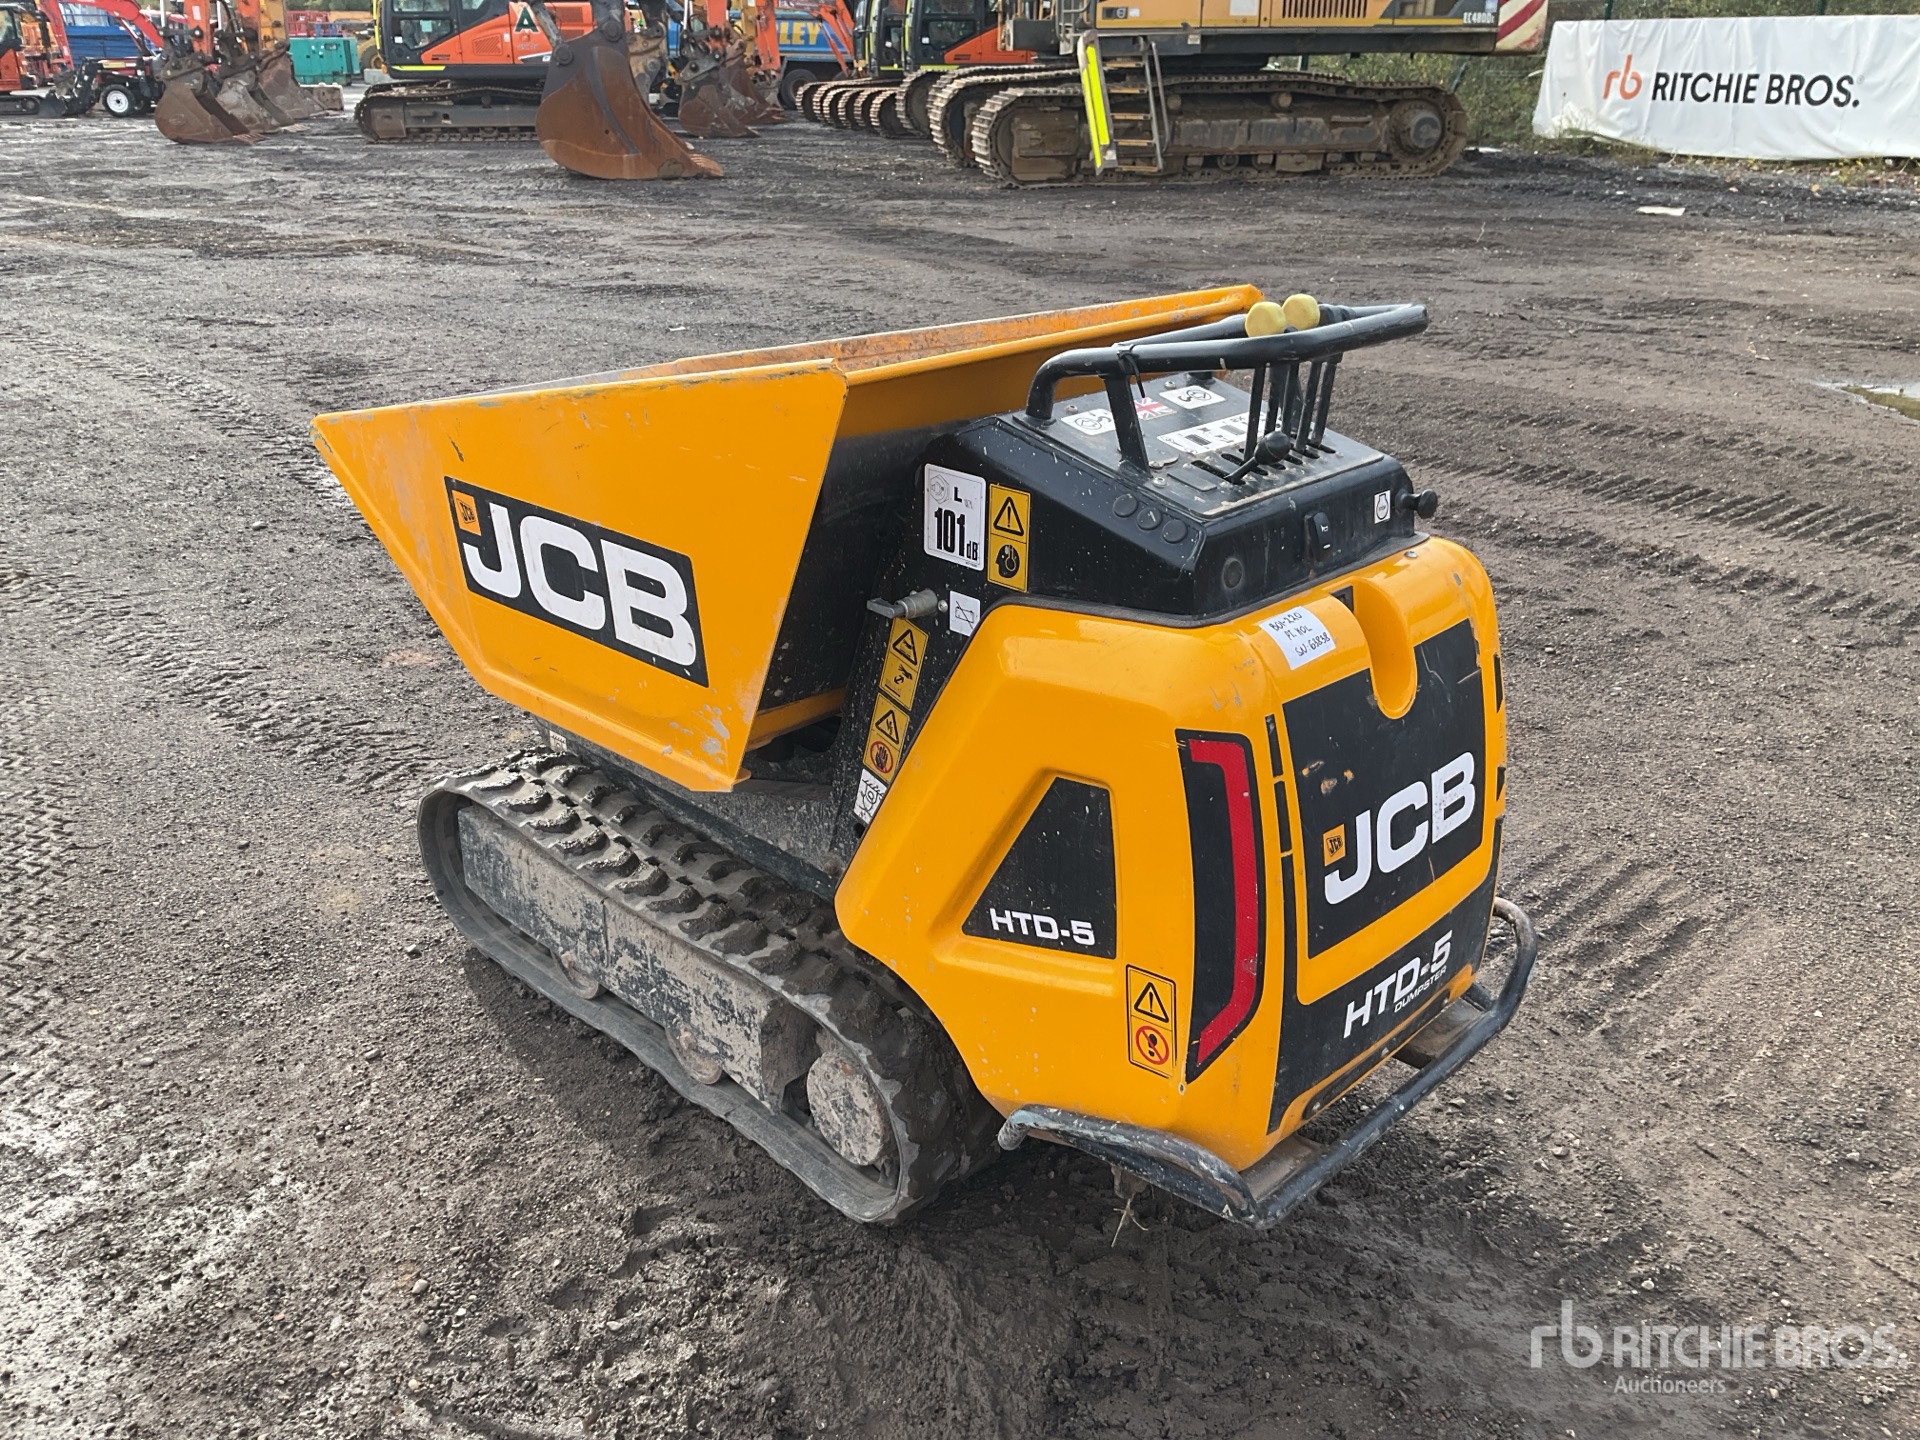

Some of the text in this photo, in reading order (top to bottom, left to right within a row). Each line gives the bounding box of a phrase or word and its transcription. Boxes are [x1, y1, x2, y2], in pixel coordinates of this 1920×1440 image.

[514, 6, 540, 32] A
[775, 21, 821, 45] LEY
[1651, 72, 1760, 104] RITCHIE
[1765, 74, 1860, 108] BROS.
[934, 507, 965, 557] 101
[463, 502, 697, 666] JCB
[1324, 752, 1476, 904] JCB
[1327, 835, 1342, 854] JCB
[989, 908, 1095, 946] HTD-5
[1344, 930, 1453, 1039] HTD-5
[1394, 965, 1447, 1013] DUMPSTER
